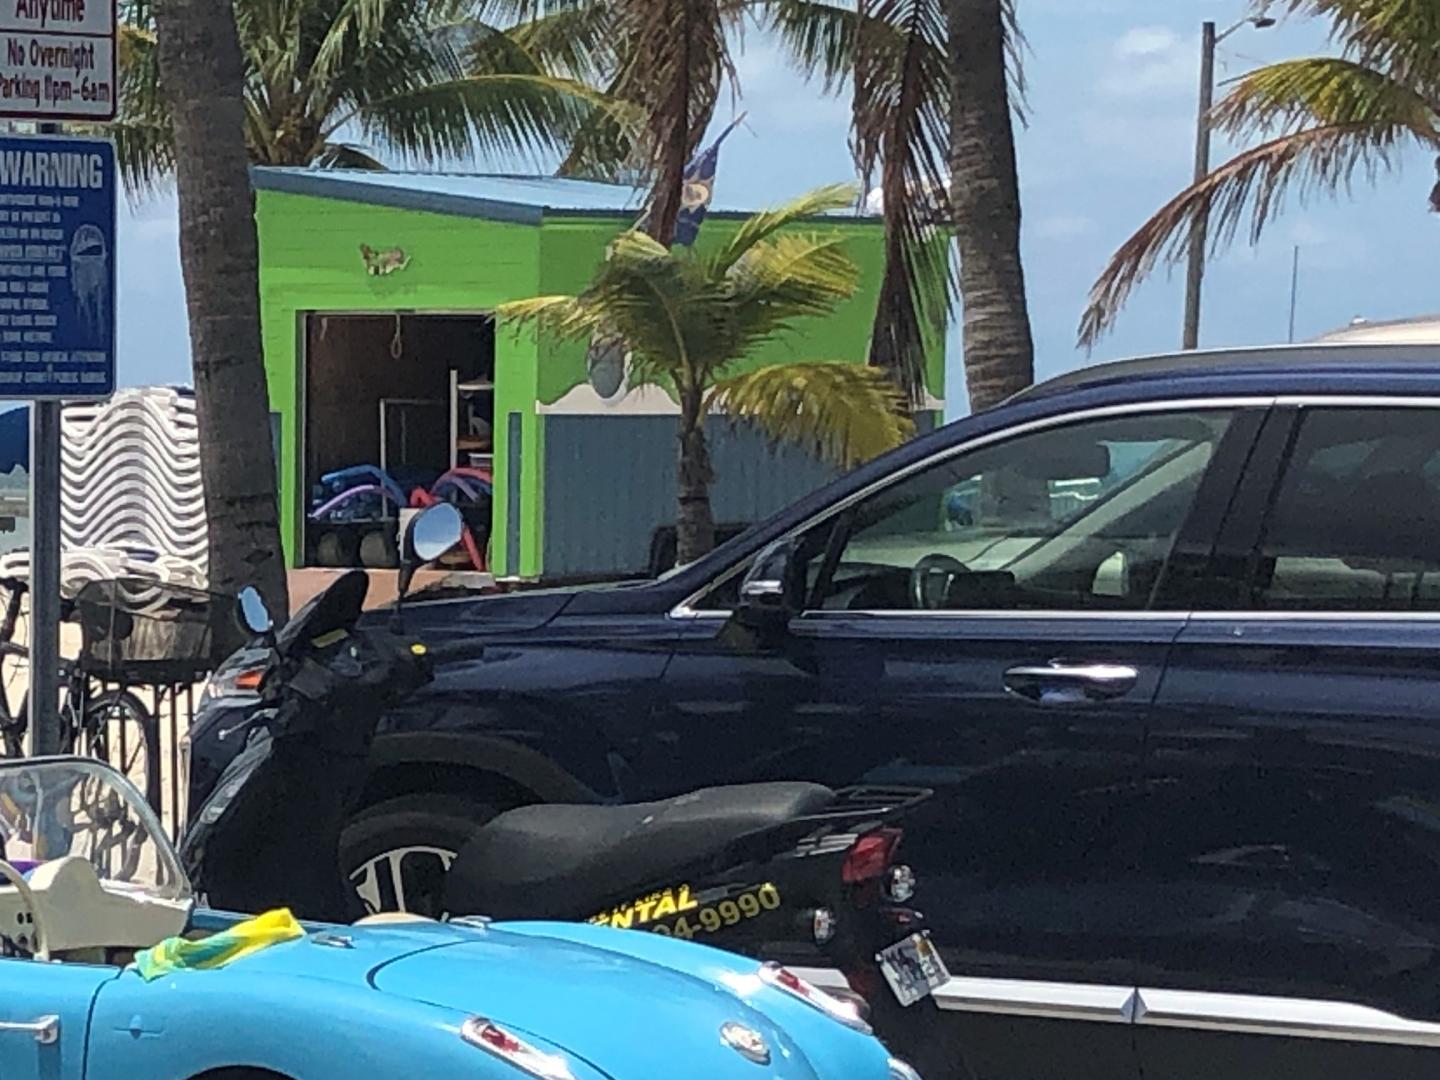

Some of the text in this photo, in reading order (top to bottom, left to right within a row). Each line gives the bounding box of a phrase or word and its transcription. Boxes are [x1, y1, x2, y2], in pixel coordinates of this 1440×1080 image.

[15, 0, 85, 28] Anytime
[7, 38, 95, 78] No Overnight
